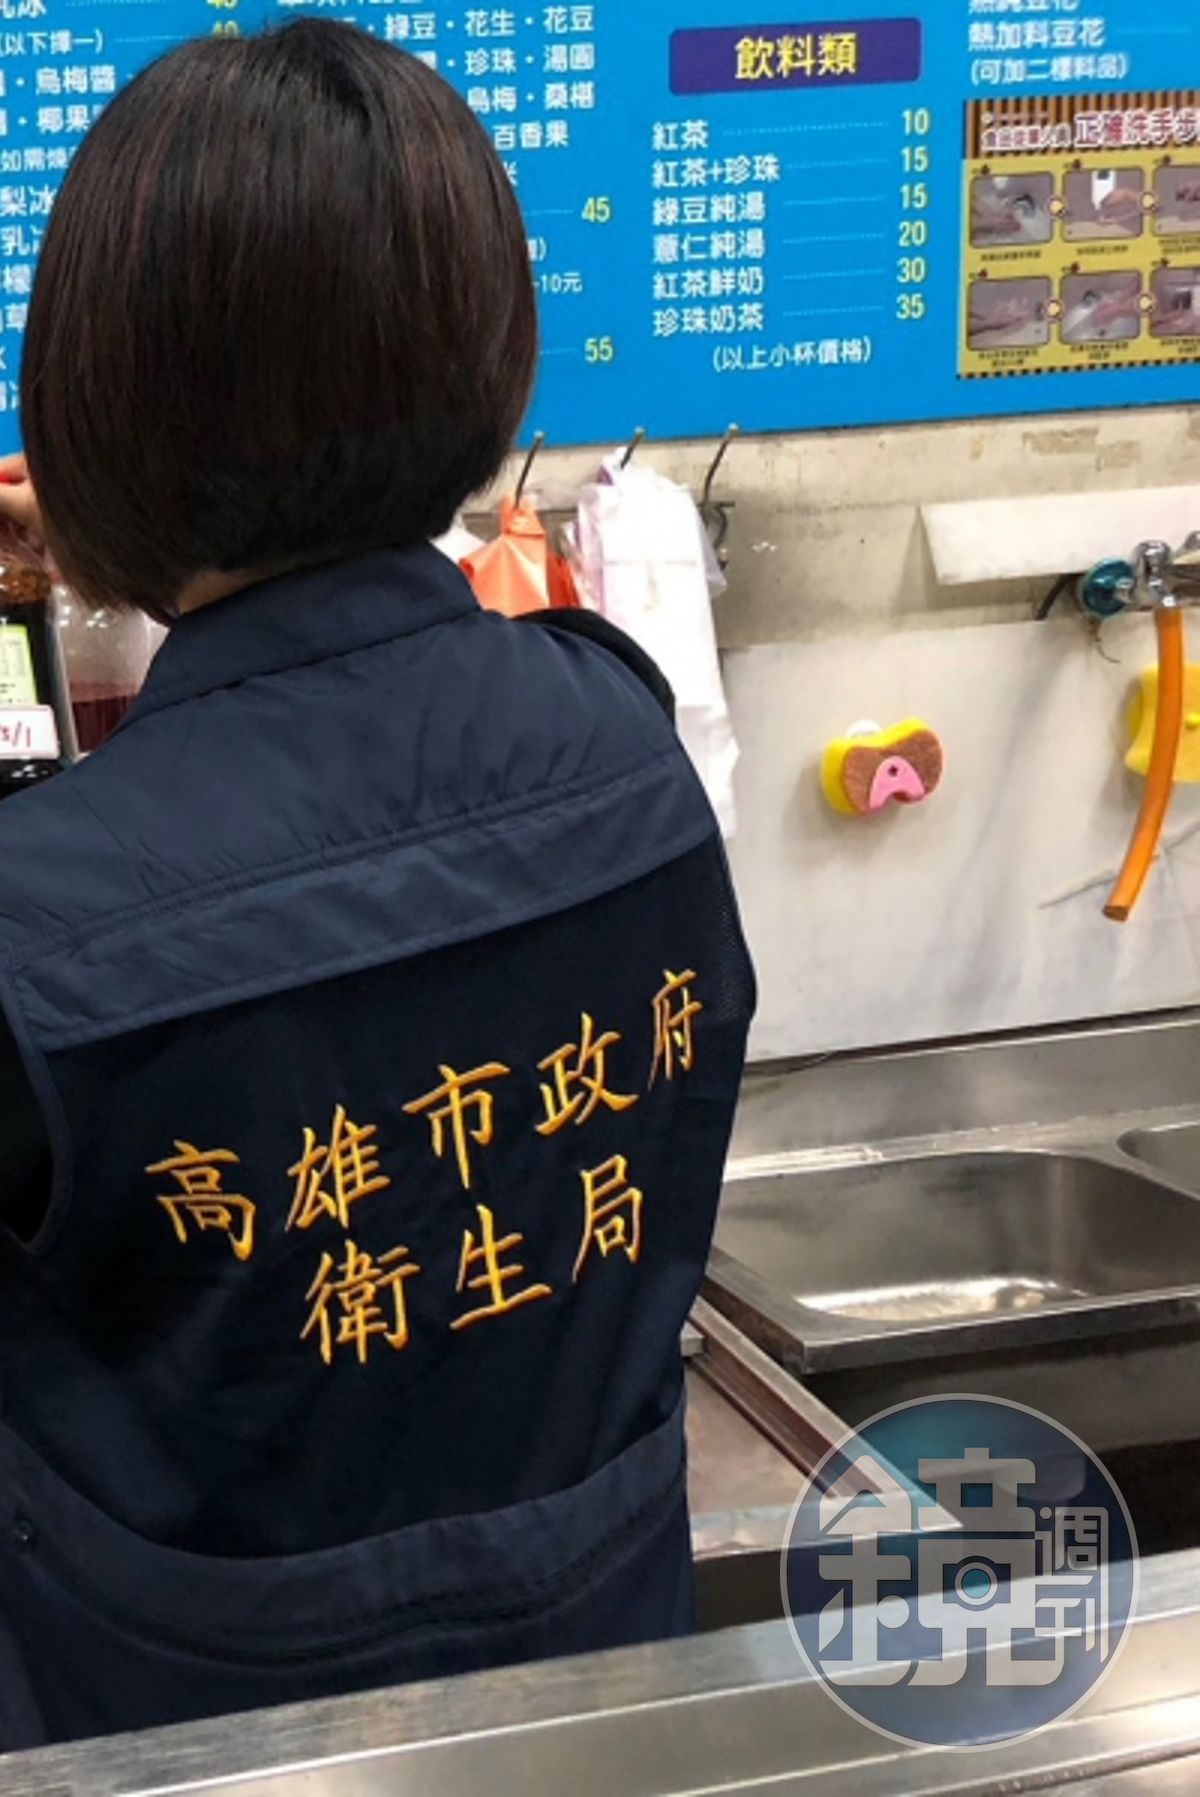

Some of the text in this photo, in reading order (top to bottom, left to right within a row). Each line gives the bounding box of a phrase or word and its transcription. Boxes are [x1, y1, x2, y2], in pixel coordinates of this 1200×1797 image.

[465, 10, 514, 36] 花生
[544, 6, 593, 33] 花豆
[969, 18, 1104, 51] 熱加料豆花
[466, 48, 516, 75] 珍珠
[545, 43, 594, 72] 湯圓
[734, 33, 857, 79] 飲料類
[36, 105, 103, 133] 椰果
[492, 121, 570, 149] 百香果
[653, 108, 929, 150] 紅茶 10
[653, 146, 928, 188] 紅茶+珍珠 15
[582, 197, 610, 222] 45
[901, 183, 927, 208] 15
[899, 220, 926, 246] 20
[654, 257, 925, 300] 紅茶鮮奶 30
[654, 294, 924, 336] 珍珠奶茶 35
[586, 337, 612, 362] 55
[145, 968, 702, 1262] 高雄市政府
[300, 1154, 644, 1367] 衛生局
